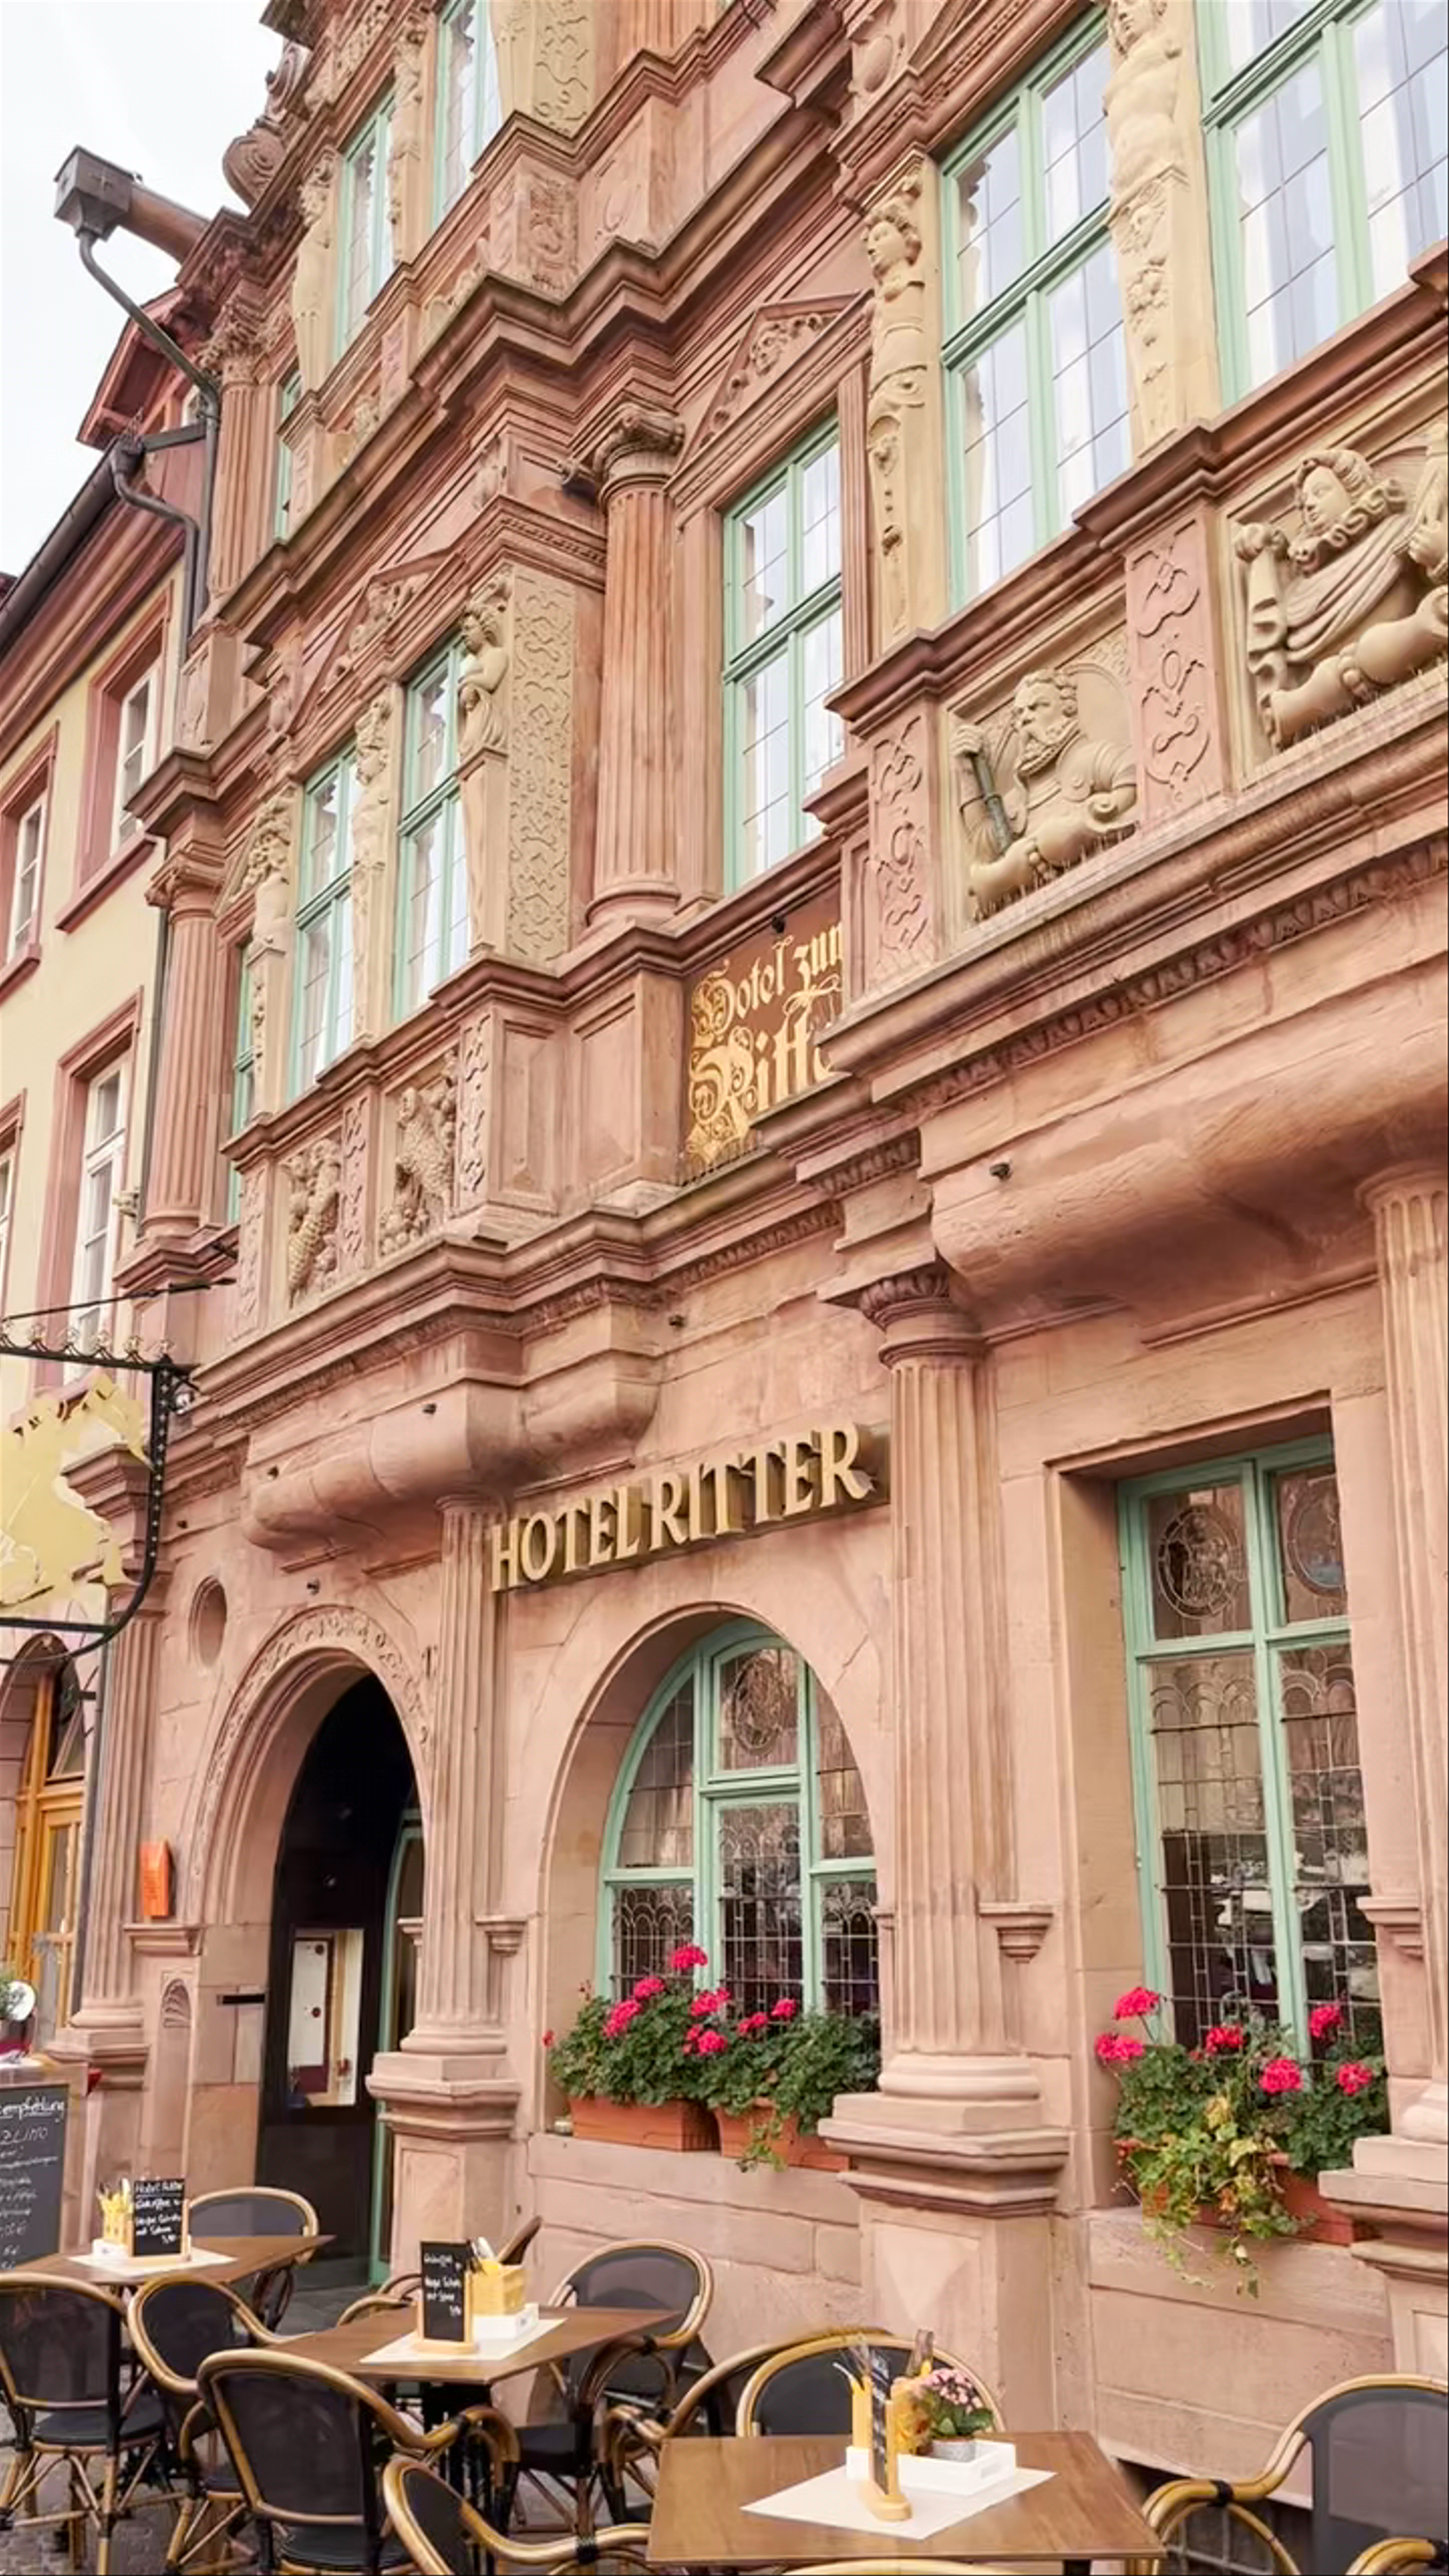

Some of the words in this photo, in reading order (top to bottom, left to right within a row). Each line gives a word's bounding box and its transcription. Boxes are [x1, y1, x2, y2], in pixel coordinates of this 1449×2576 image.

[691, 935, 794, 1048] Hotel
[492, 1486, 641, 1592] HOTEL
[650, 1422, 875, 1552] RITTER
